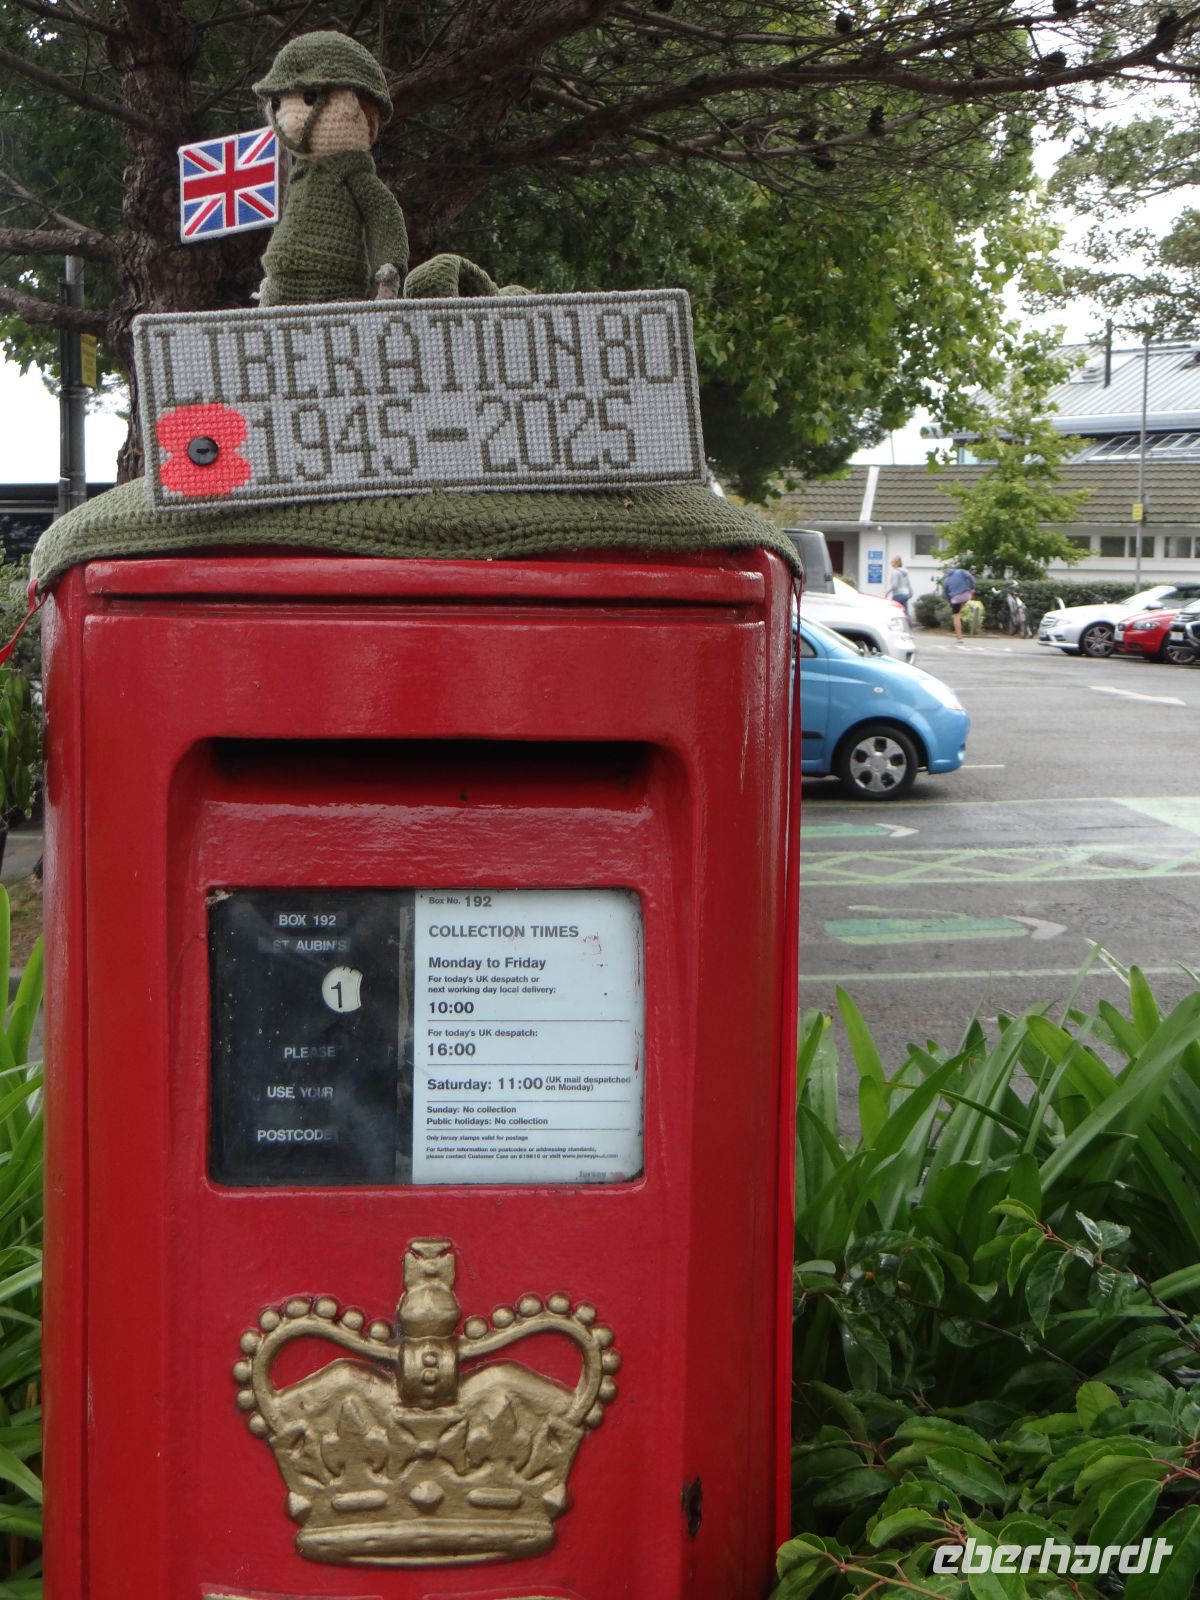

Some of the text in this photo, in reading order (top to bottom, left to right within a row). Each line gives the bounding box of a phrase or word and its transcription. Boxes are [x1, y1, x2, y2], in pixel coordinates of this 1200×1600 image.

[251, 391, 637, 486] 1945-2025
[428, 895, 493, 908] Box No. 192
[279, 914, 337, 926] BOX 192
[428, 925, 580, 938] COLLECTION TIMES
[273, 939, 290, 951] ST
[428, 957, 546, 971] Monday to Friday
[444, 976, 473, 985] today's
[490, 976, 529, 985] despatch
[330, 981, 343, 1009] 1
[447, 986, 480, 995] working
[482, 986, 497, 995] day
[499, 986, 519, 994] local
[521, 986, 556, 995] delivery:
[429, 1001, 475, 1014] 10:00
[427, 1029, 538, 1038] For today's UK despatch:
[284, 1046, 336, 1058] PLEASE
[428, 1043, 476, 1056] 16:00
[427, 1078, 492, 1092] Saturday:
[498, 1077, 543, 1090] 11:00
[545, 1076, 561, 1084] (UK
[583, 1076, 631, 1084] despatched
[267, 1086, 333, 1098] USE YOUR
[427, 1106, 460, 1114] Sunday:
[455, 1117, 492, 1126] holidays:
[509, 1117, 548, 1125] collection
[257, 1129, 333, 1141] POSTCODE
